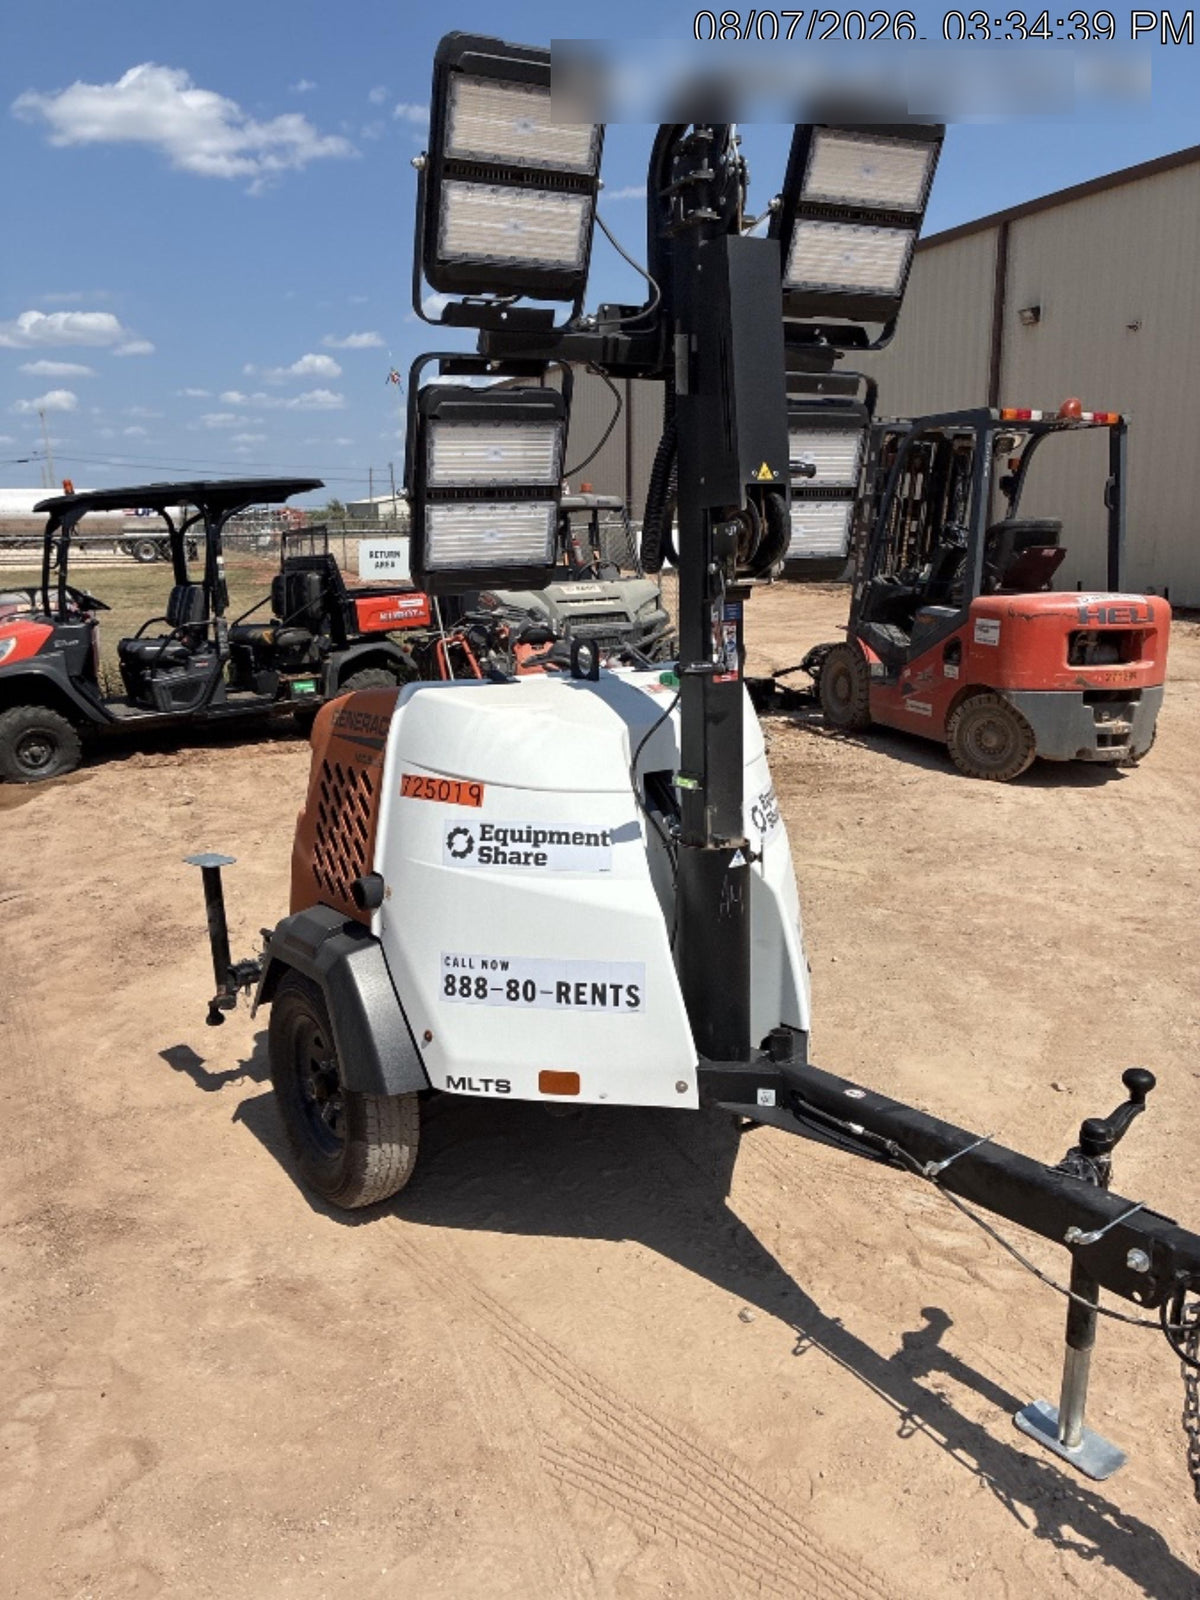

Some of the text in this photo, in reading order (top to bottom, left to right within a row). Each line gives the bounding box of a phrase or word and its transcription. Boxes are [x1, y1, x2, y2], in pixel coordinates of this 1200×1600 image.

[369, 550, 401, 559] RETURN
[402, 775, 484, 807] 725019
[479, 823, 610, 848] Equipment
[478, 845, 547, 866] Share
[444, 956, 510, 972] CALL NOW
[446, 1074, 511, 1094] MLTS
